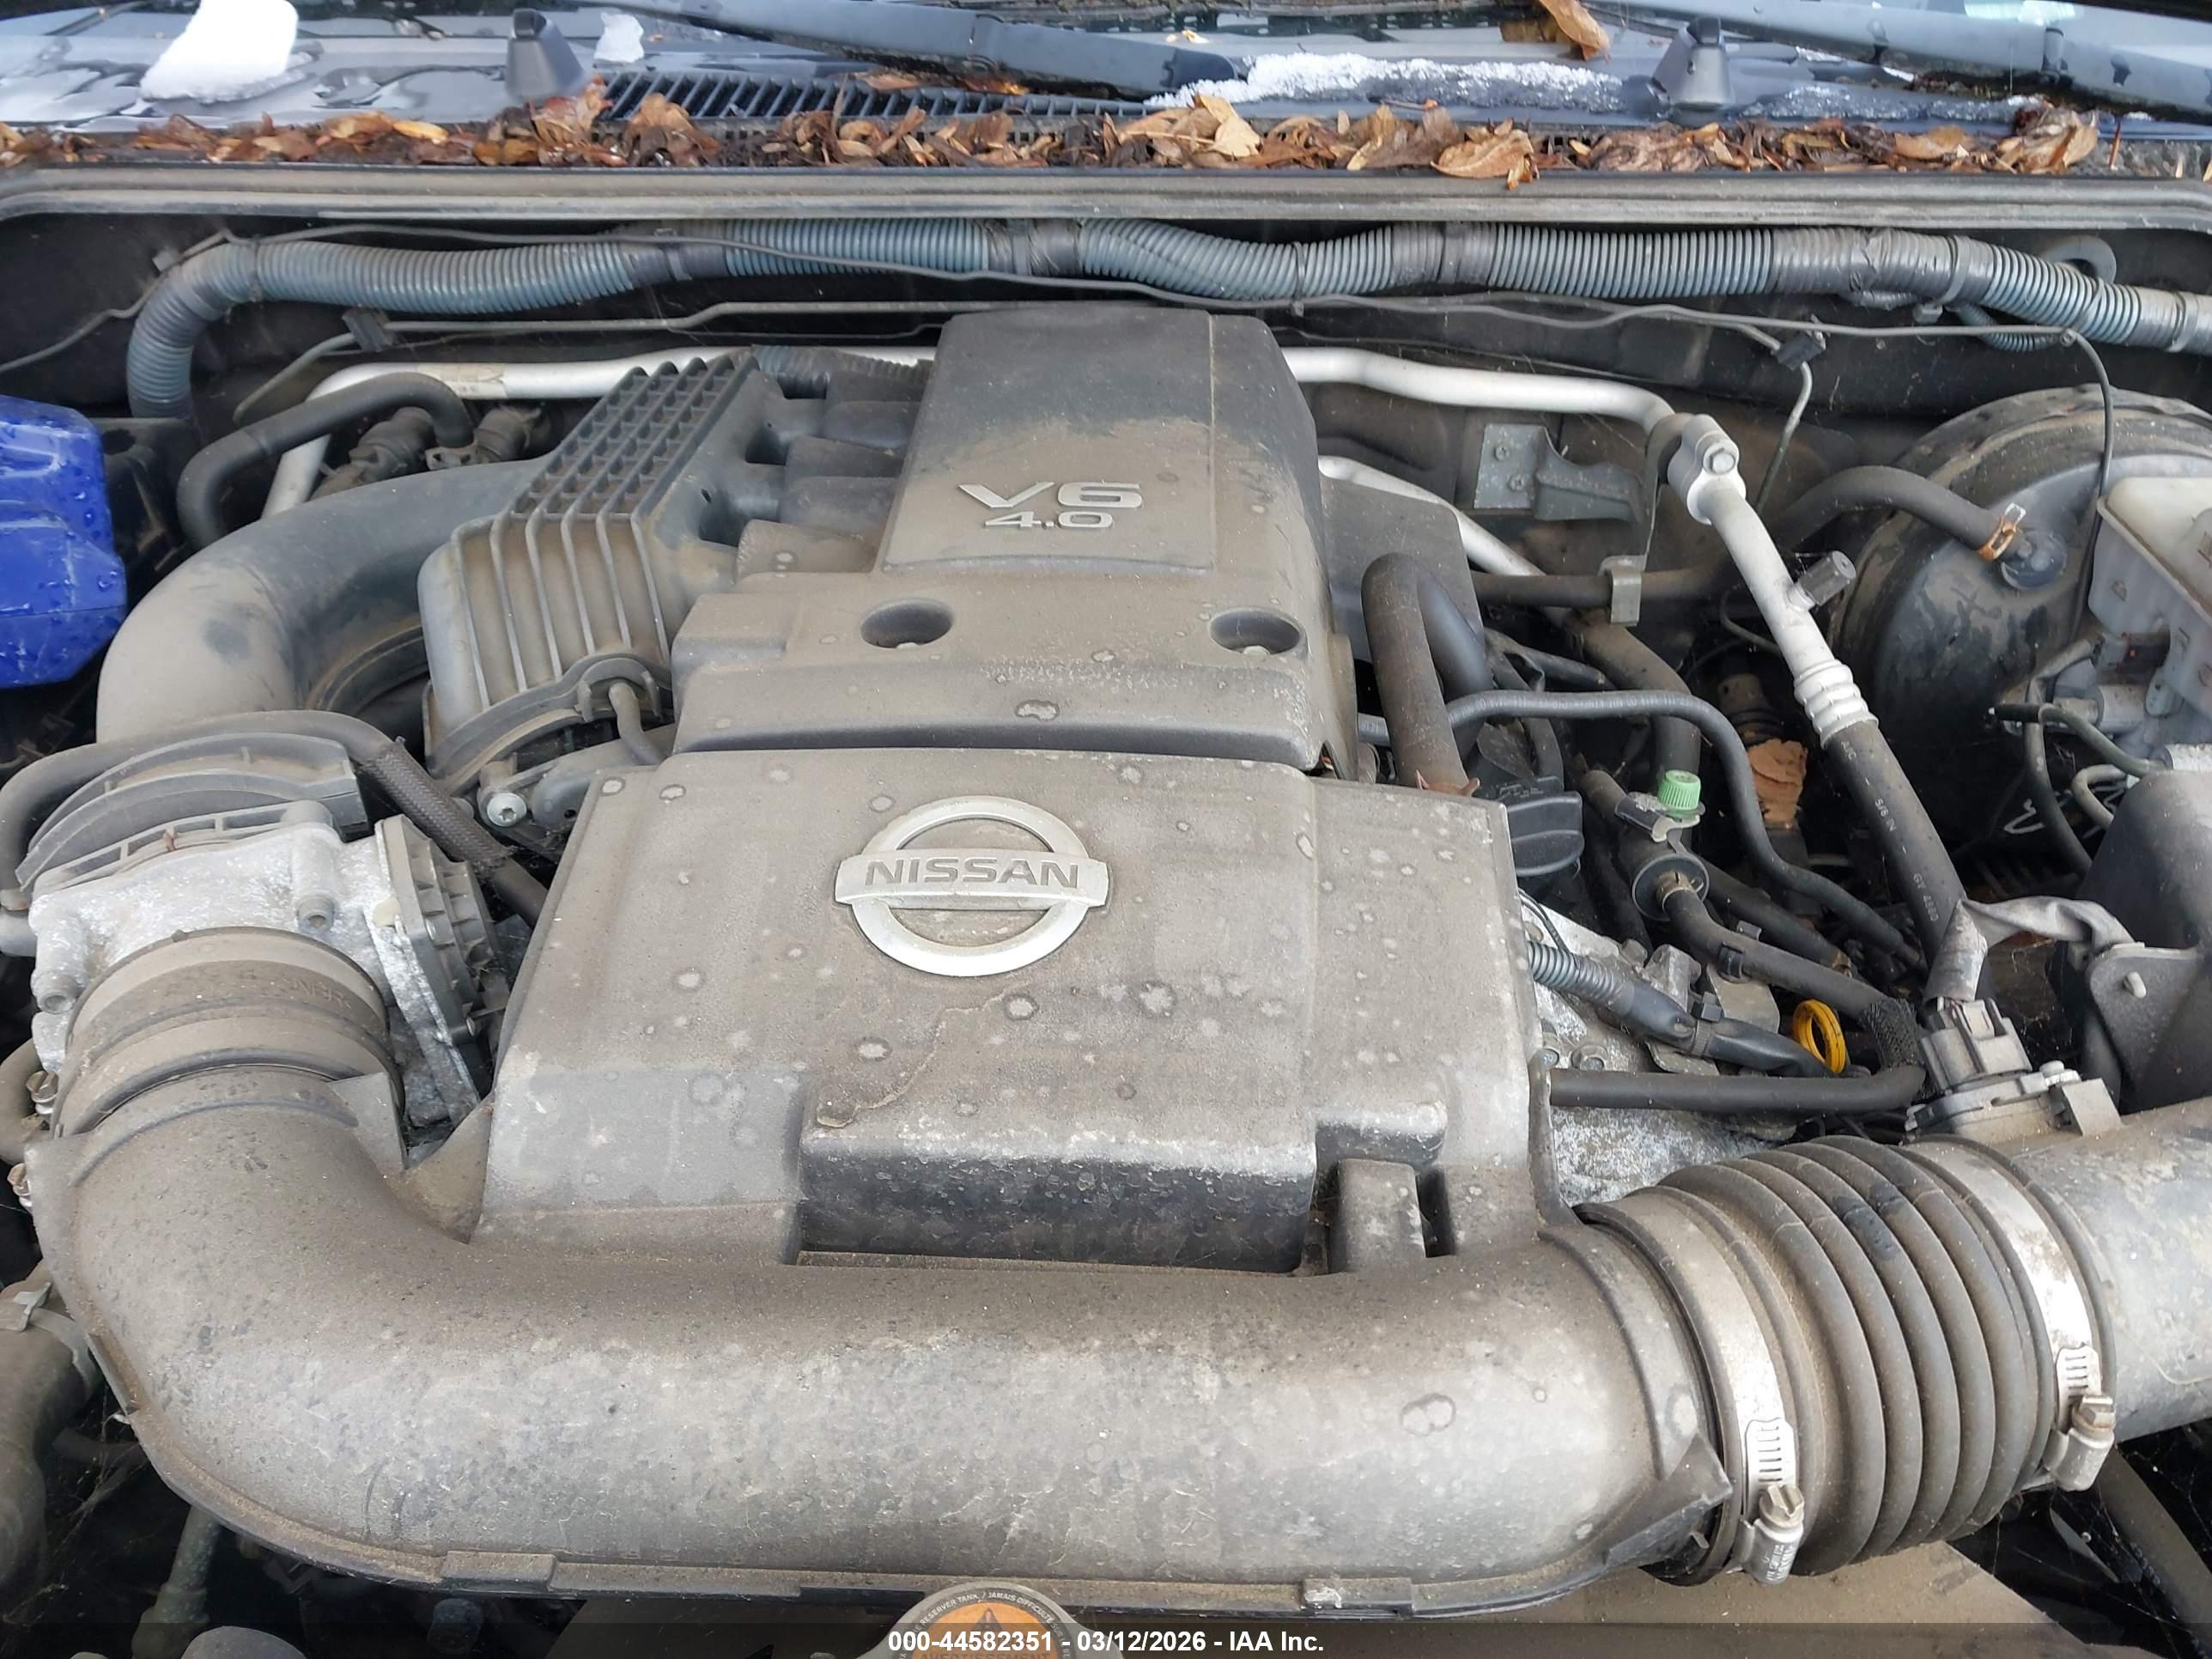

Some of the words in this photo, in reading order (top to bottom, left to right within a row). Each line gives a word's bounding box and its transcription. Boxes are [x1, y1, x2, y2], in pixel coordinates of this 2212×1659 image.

[957, 481, 1143, 508] V6
[985, 511, 1114, 528] 4.0
[865, 857, 1079, 889] NISSAN
[988, 1592, 1017, 1601] JAMAIS
